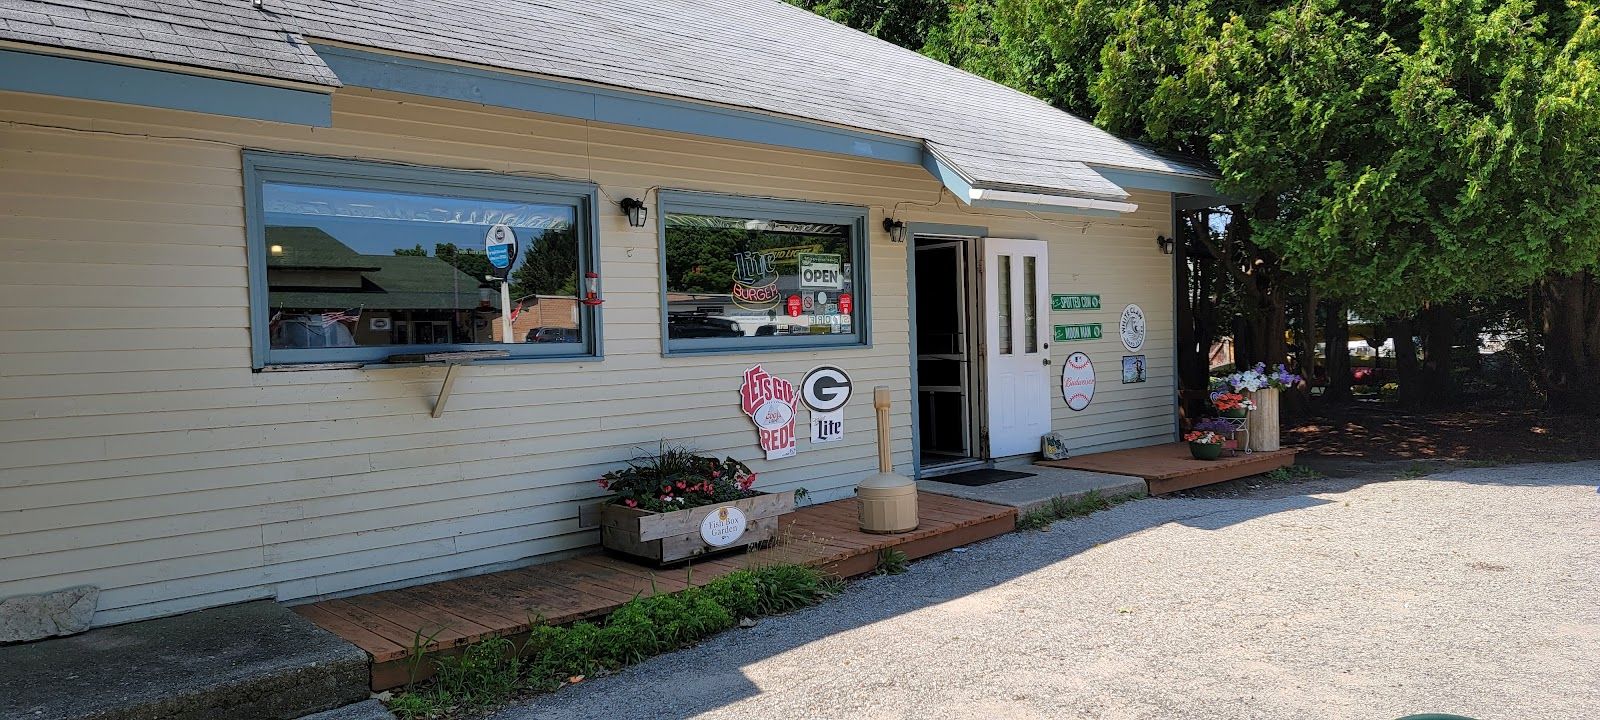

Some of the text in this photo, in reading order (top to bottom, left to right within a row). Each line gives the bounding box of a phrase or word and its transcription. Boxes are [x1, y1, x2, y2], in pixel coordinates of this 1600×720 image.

[734, 251, 776, 285] Lite
[803, 269, 838, 283] OPEN
[734, 283, 778, 301] BURGER
[1060, 296, 1081, 308] SPOTTED
[1121, 307, 1143, 334] WHITE CLAW
[1065, 326, 1080, 339] MOON
[1080, 325, 1092, 337] MAN
[773, 377, 793, 403] GO
[1065, 377, 1095, 388] Budweiser
[818, 420, 841, 440] Lite
[761, 426, 795, 451] RED!
[709, 517, 739, 529] Fish Box
[711, 526, 738, 537] Garden
